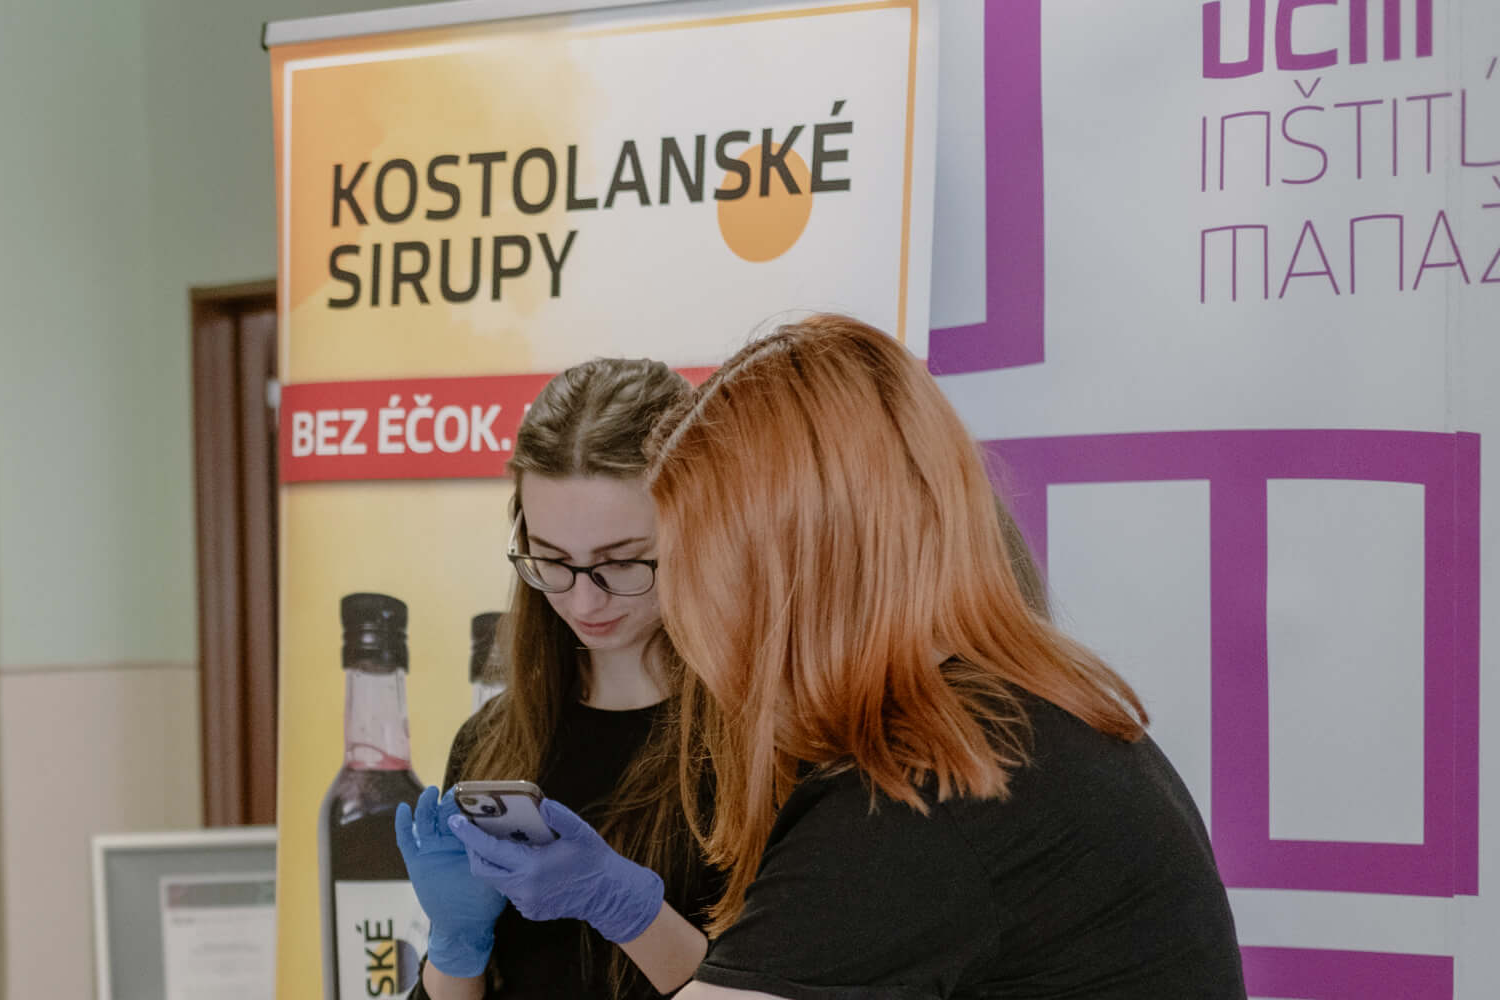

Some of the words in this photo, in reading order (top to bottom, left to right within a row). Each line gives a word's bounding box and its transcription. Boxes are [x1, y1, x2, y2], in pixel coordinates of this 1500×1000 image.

[331, 100, 854, 228] KOSTOLANSKÉ
[327, 230, 579, 309] SIRUPY
[291, 404, 367, 457] BEZ
[377, 394, 512, 455] ÉČOK.
